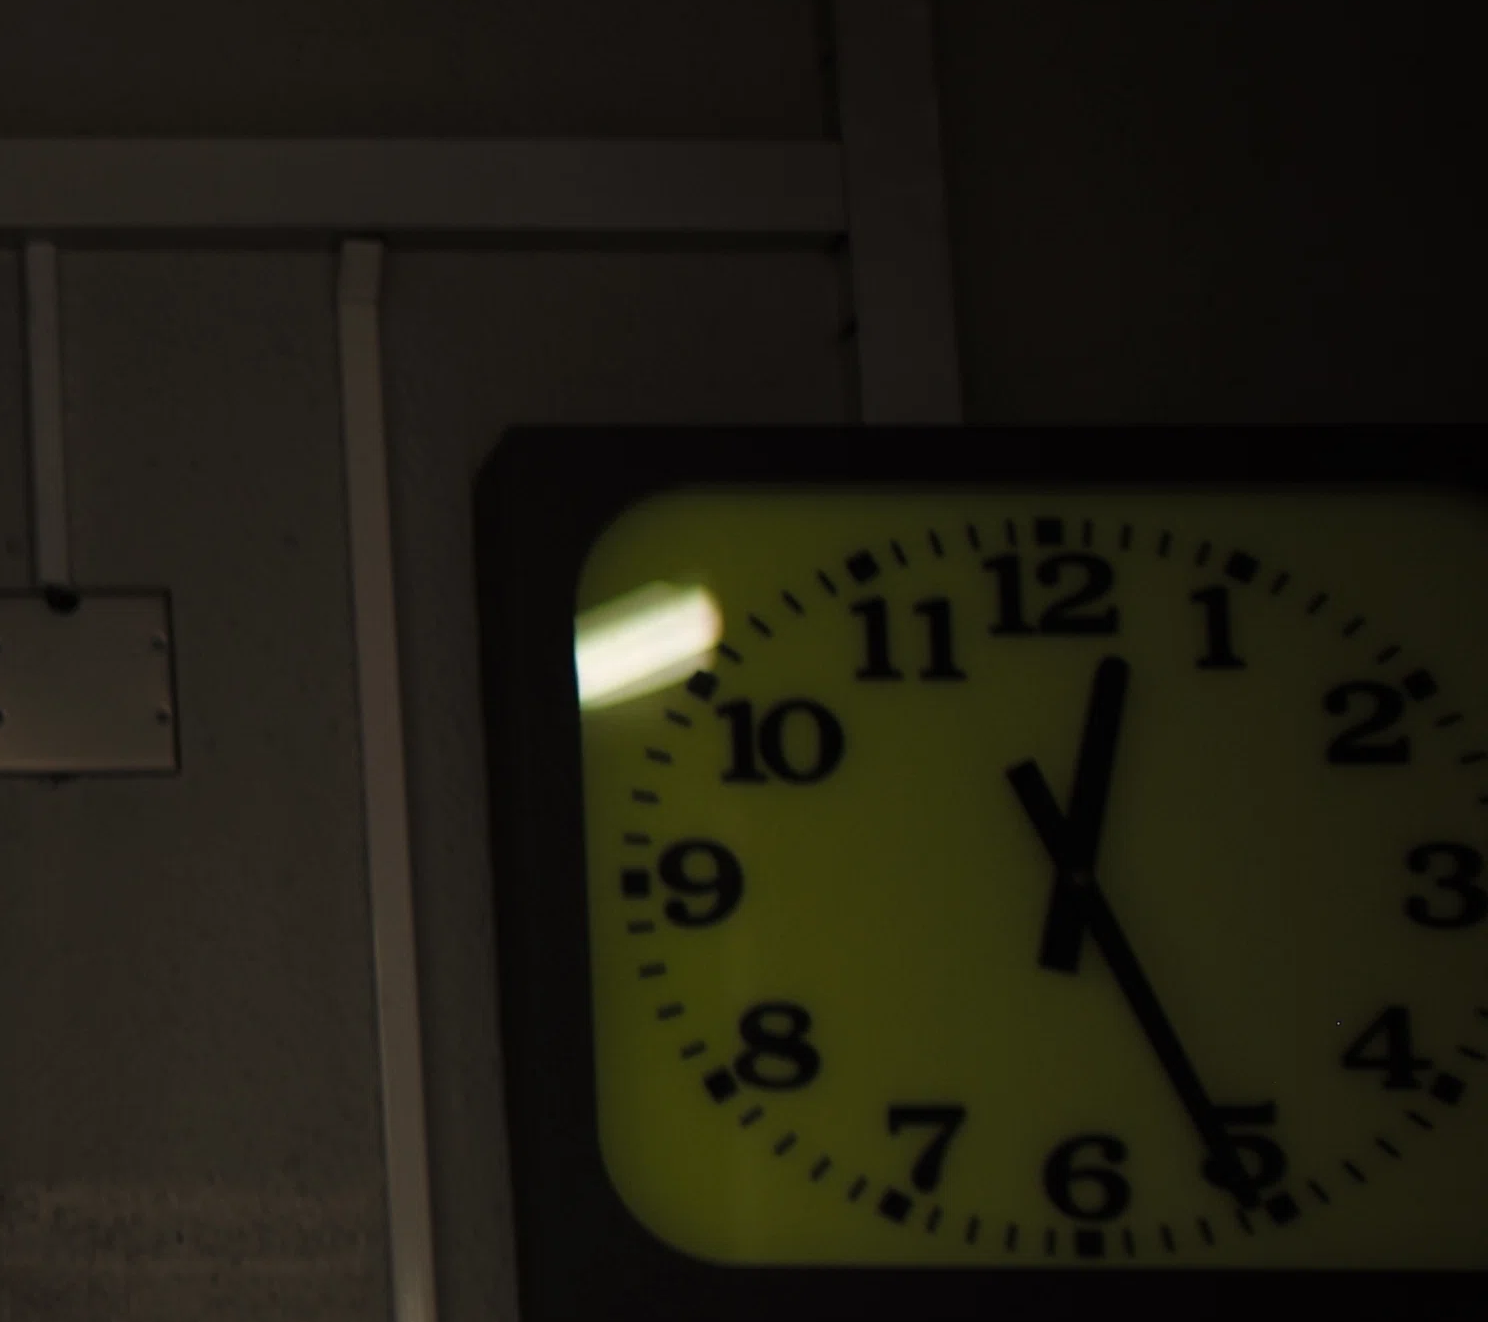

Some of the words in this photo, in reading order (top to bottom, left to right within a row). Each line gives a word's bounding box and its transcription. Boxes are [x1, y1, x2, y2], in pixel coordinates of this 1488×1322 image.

[984, 552, 1121, 635] 12
[1190, 584, 1247, 671] 1
[851, 596, 967, 683] 11
[716, 698, 846, 786] 10
[1321, 681, 1411, 766] 2
[656, 838, 745, 929] 9
[1404, 840, 1488, 930] 3
[735, 1001, 822, 1092] 8
[1341, 1005, 1434, 1093] 4
[885, 1104, 969, 1193] 7
[1042, 1133, 1132, 1224] 6
